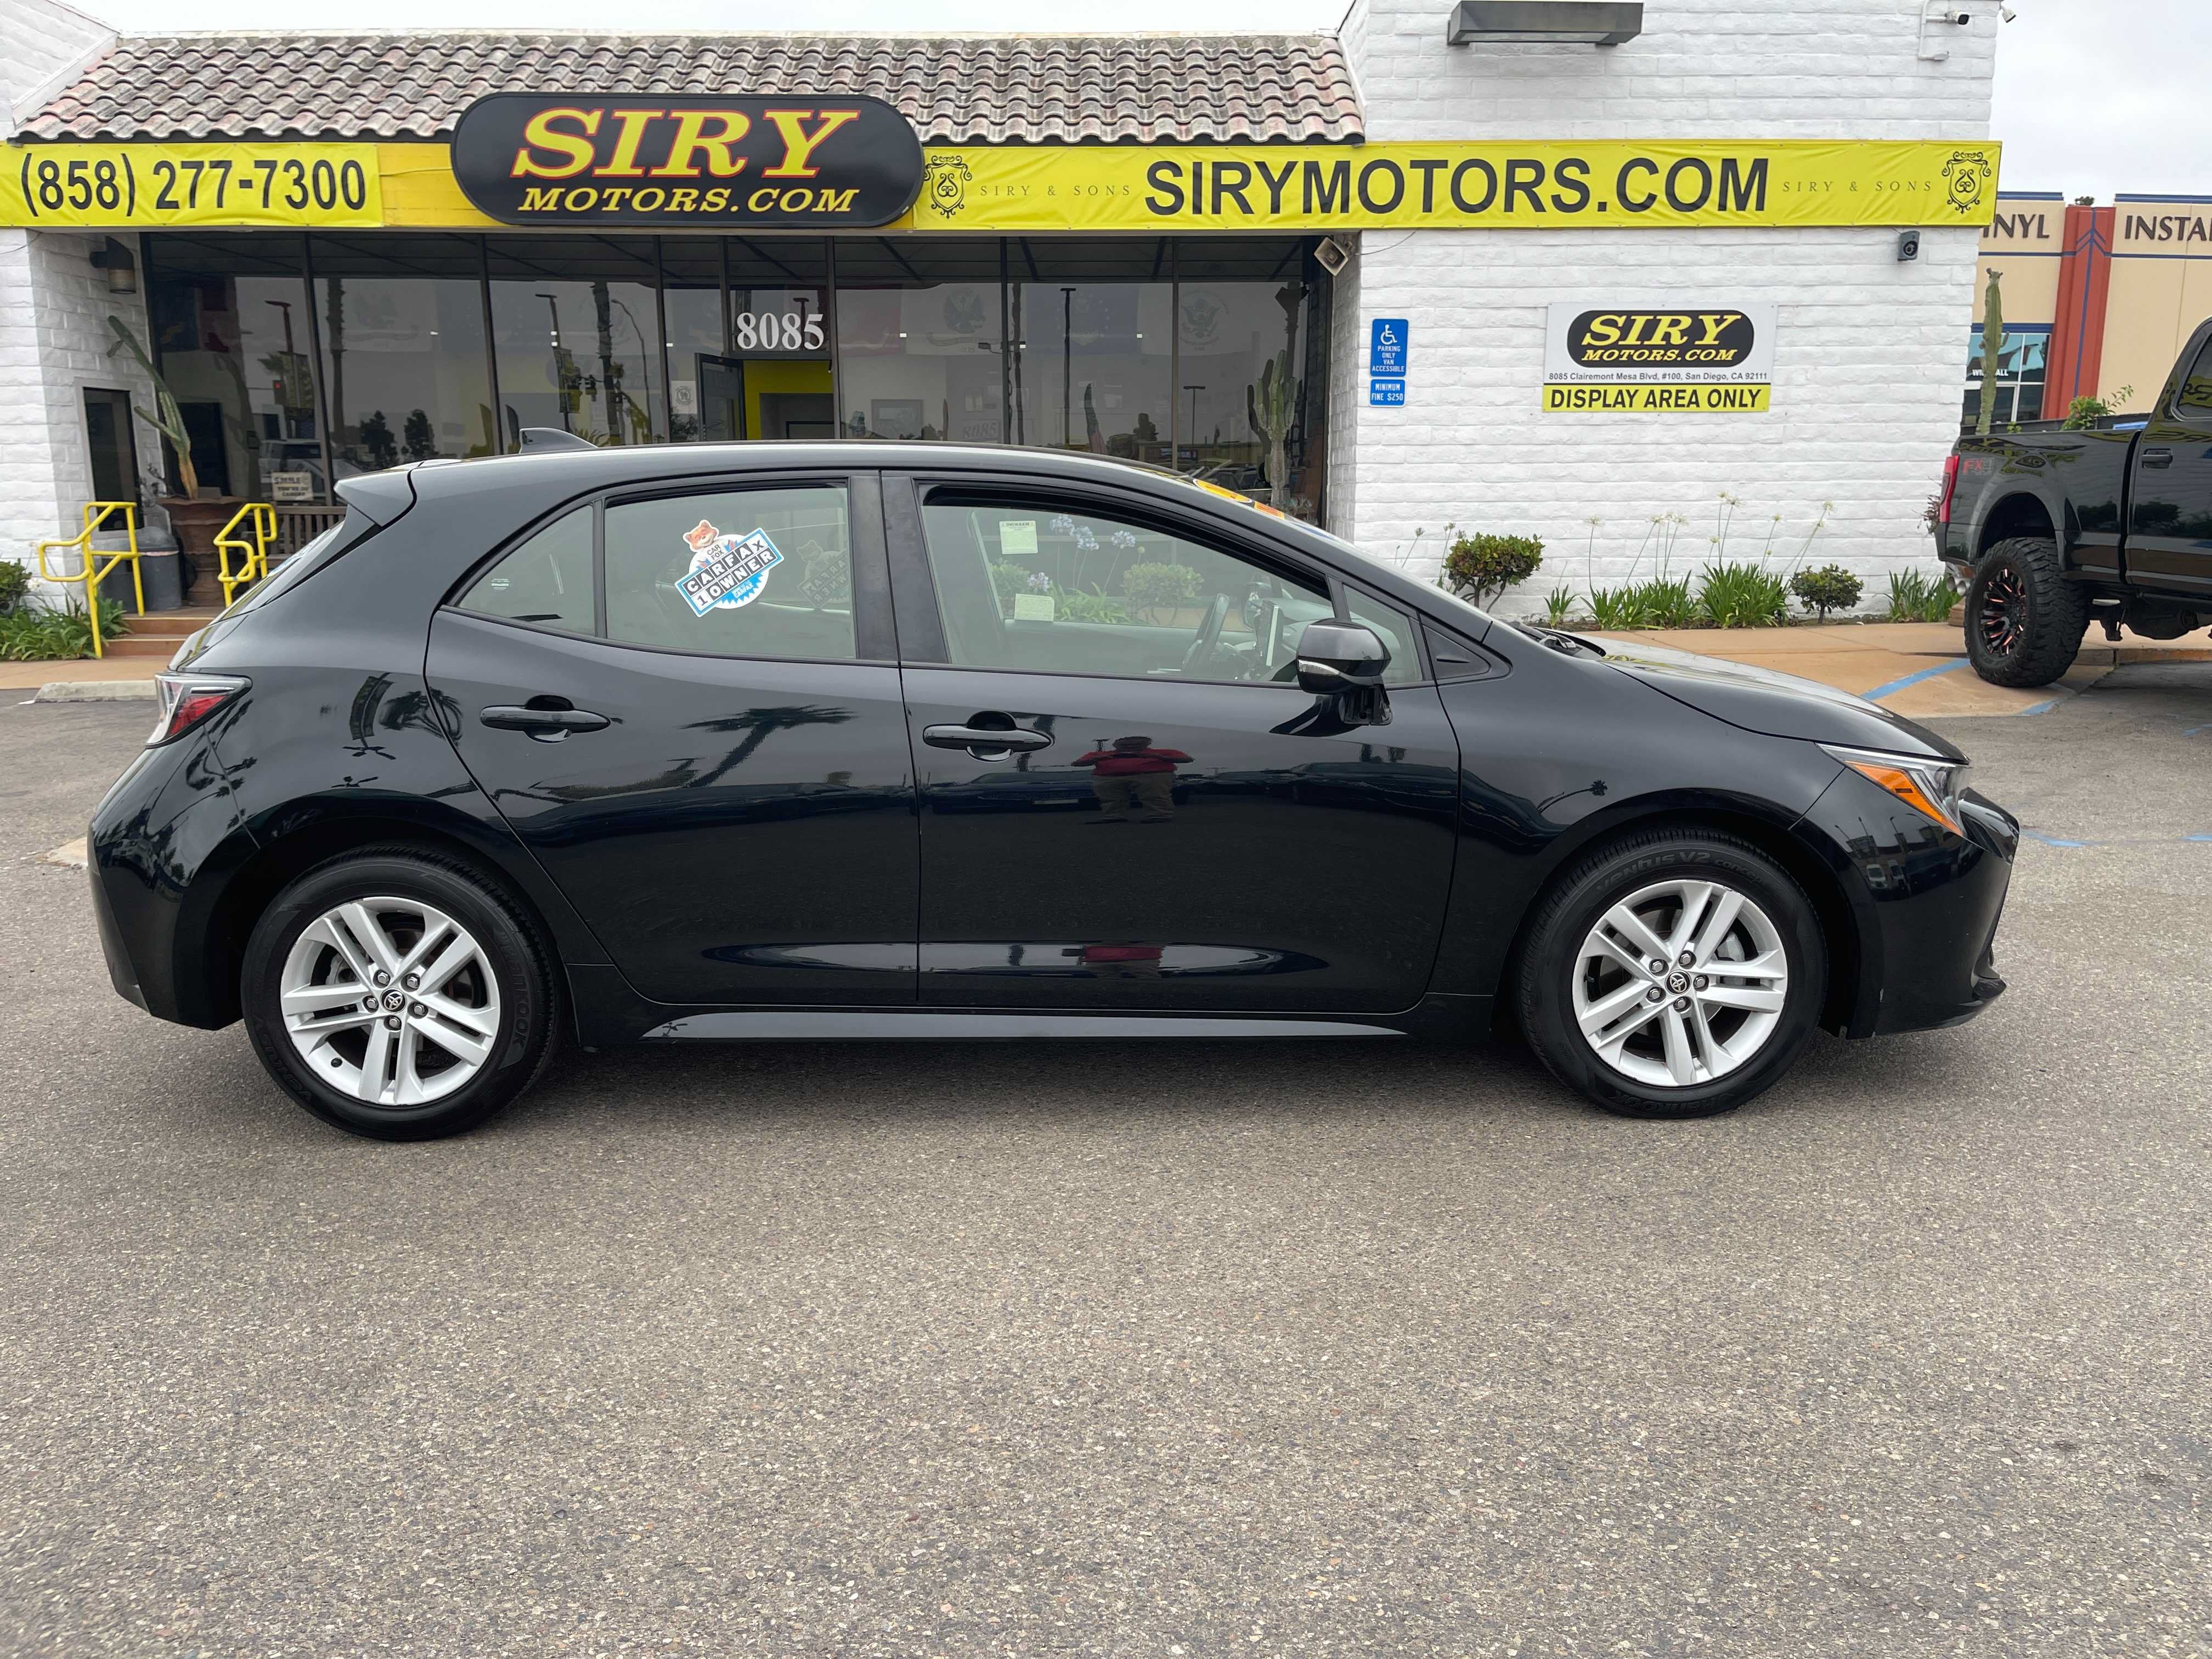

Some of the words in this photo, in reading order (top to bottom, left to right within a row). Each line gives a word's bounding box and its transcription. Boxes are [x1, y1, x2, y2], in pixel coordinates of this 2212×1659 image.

[510, 107, 861, 179] SIRY
[21, 153, 136, 217] (858)
[153, 159, 366, 211] 277-7300
[980, 184, 1031, 196] SIRY
[1047, 185, 1057, 196] &
[1073, 184, 1131, 196] SONS
[1145, 157, 1769, 216] SIRYMOTORS.COM
[1782, 180, 1834, 193] SIRY
[1849, 182, 1859, 193] &
[1875, 179, 1932, 192] SONS
[517, 187, 860, 213] MOTORS.COM
[736, 312, 825, 351] 8085
[1581, 314, 1742, 346] SIRY
[1581, 349, 1738, 362] MOTORS.COM
[1375, 383, 1401, 391] MINIMUM
[1639, 373, 1660, 381] Blvd,
[1662, 373, 1683, 381] #100,
[1703, 373, 1729, 382] Diego,
[1387, 393, 1403, 401] $250
[1551, 388, 1639, 408] DISPLAY
[1644, 388, 1700, 408] AREA
[1707, 388, 1762, 408] ONLY
[707, 544, 721, 556] CAR
[711, 550, 724, 561] FOX
[687, 540, 764, 592] CARFAX
[697, 595, 708, 606] 1
[709, 550, 774, 597] OWNER
